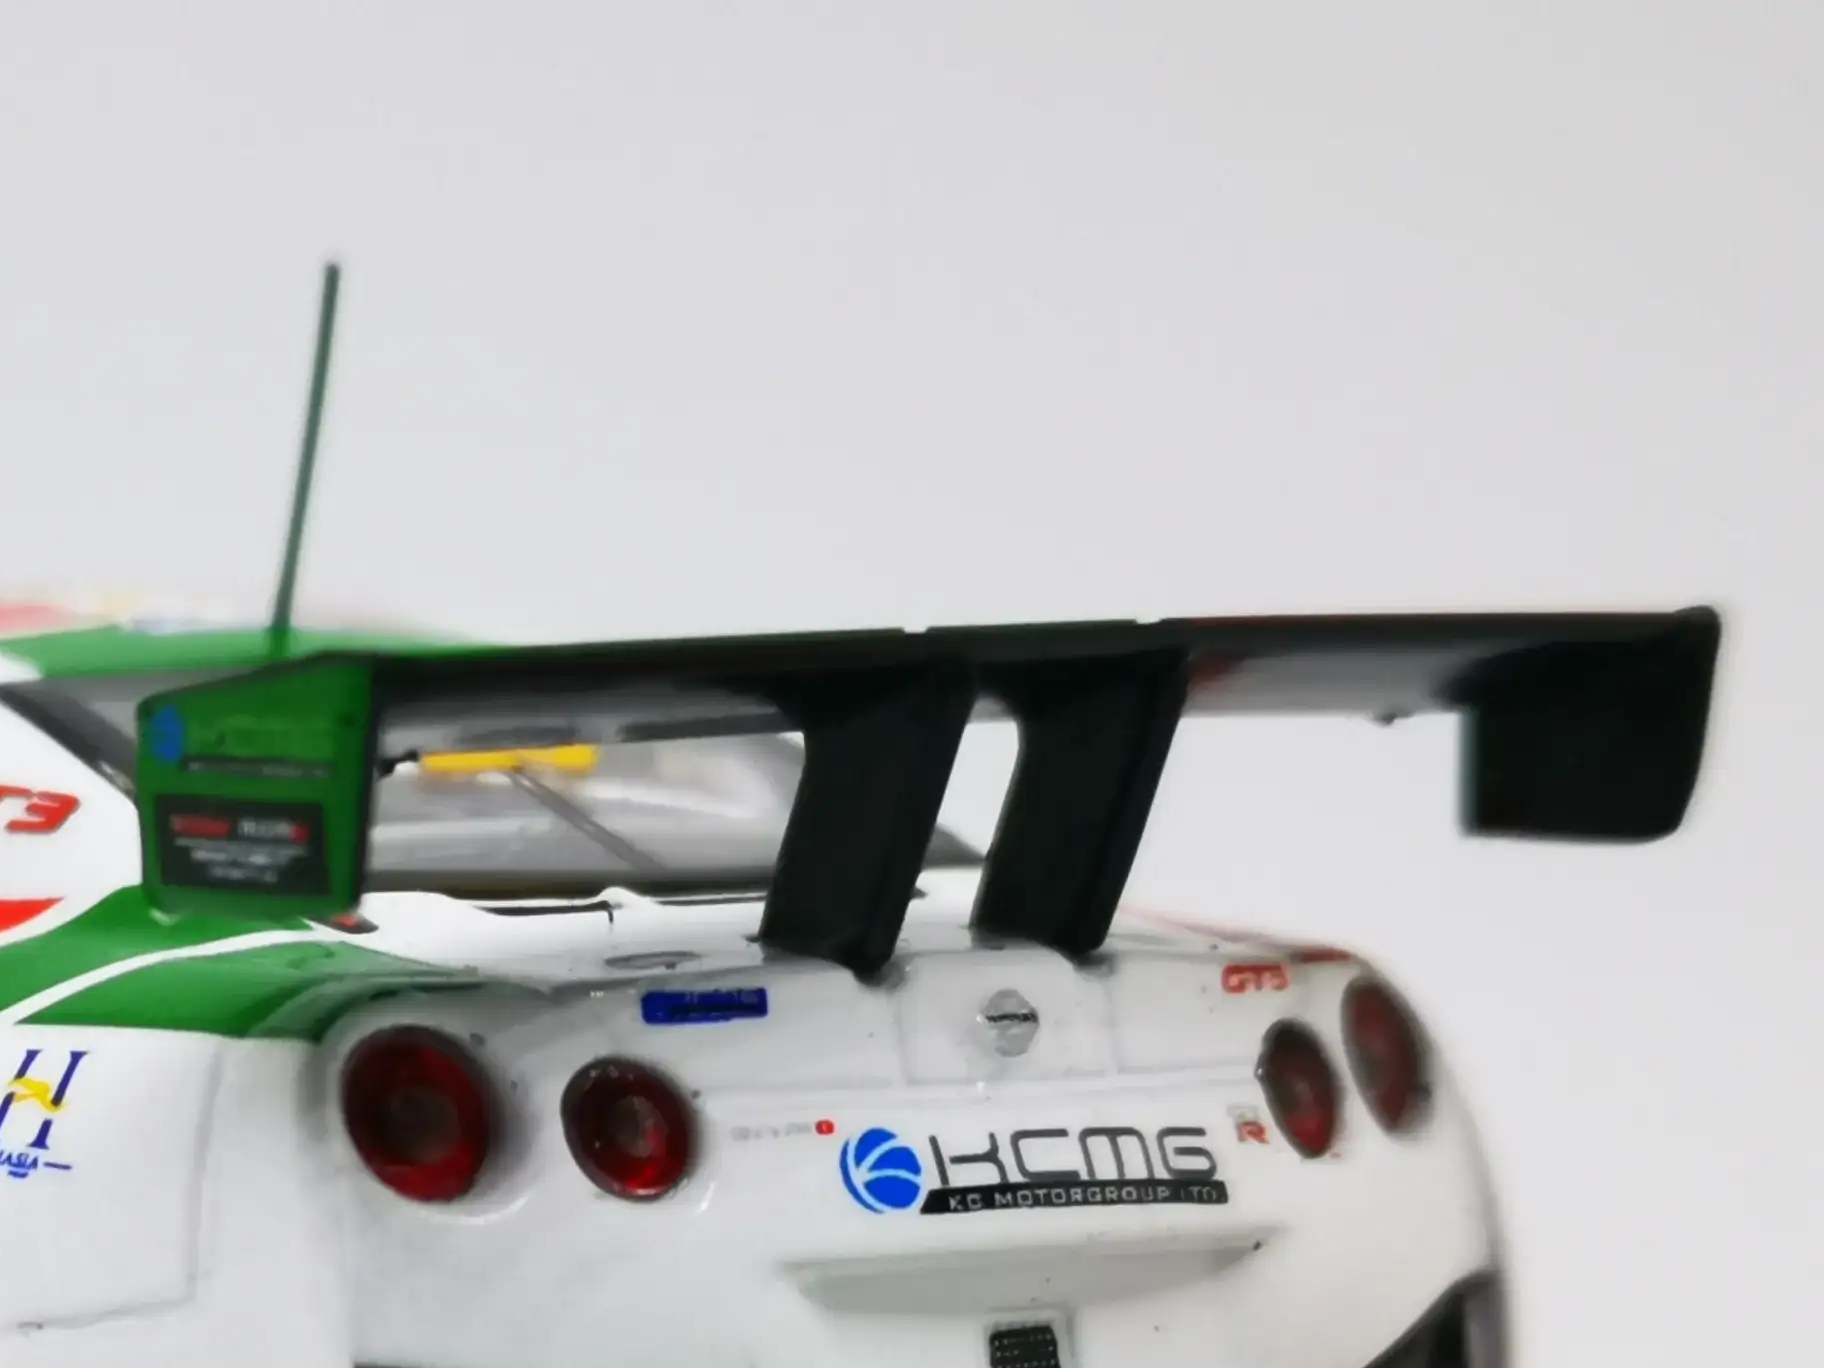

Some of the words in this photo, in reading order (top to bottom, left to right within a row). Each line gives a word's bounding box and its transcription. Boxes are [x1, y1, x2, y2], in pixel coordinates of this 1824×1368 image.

[929, 1127, 1217, 1187] KCMG
[948, 1192, 982, 1211] KC
[994, 1186, 1170, 1208] MOTORGROUP
